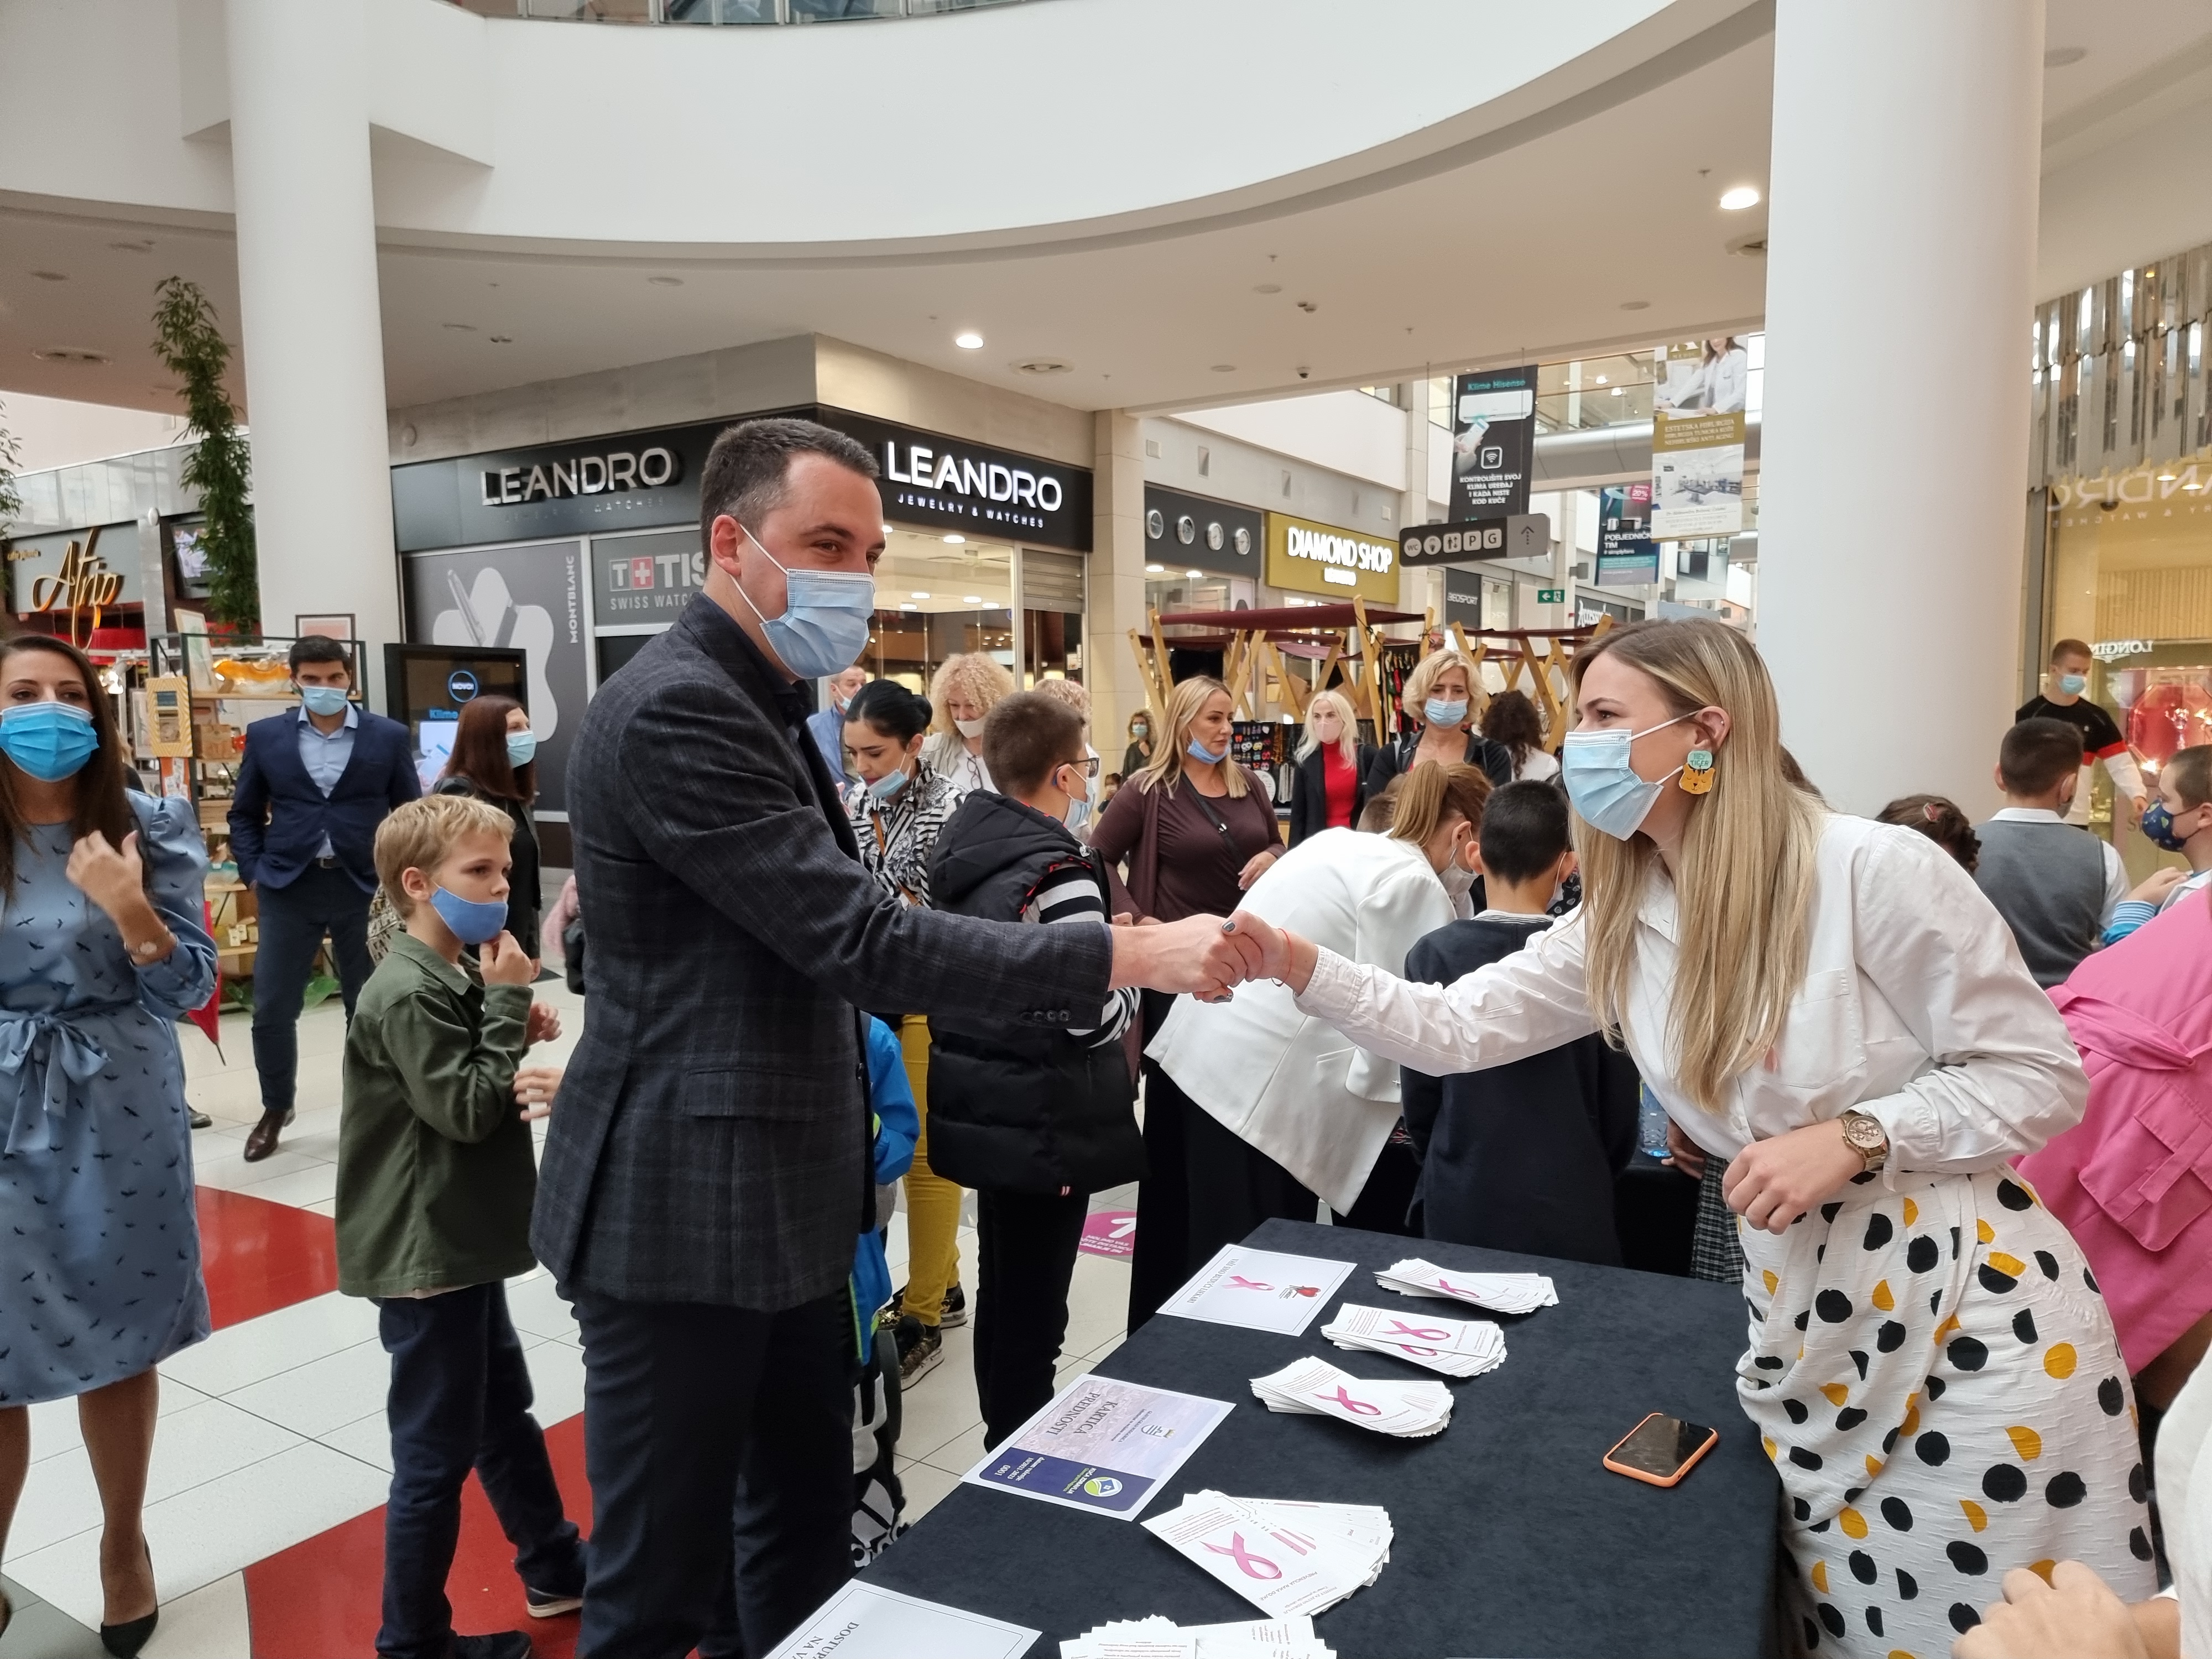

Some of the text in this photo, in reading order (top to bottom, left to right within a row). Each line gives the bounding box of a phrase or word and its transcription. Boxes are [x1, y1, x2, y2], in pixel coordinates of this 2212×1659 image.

[481, 447, 672, 505] LEANDRO
[888, 441, 1062, 512] LEANDRO
[898, 494, 1044, 528] JEWELRY & WATCHES
[1288, 527, 1392, 574] DIAMOND SHOP
[1469, 535, 1476, 546] P
[1488, 533, 1496, 544] G
[655, 554, 705, 588] TIS
[566, 555, 578, 644] MONTBLANC
[611, 593, 692, 610] SWISS WATC
[1046, 1392, 1101, 1435] PREDNOSTI
[1073, 1401, 1119, 1435] KARTICA
[994, 1464, 1012, 1475] 0001
[1259, 1590, 1276, 1601] DOJKE
[1275, 1584, 1290, 1593] RAKA
[804, 1635, 824, 1649] NA
